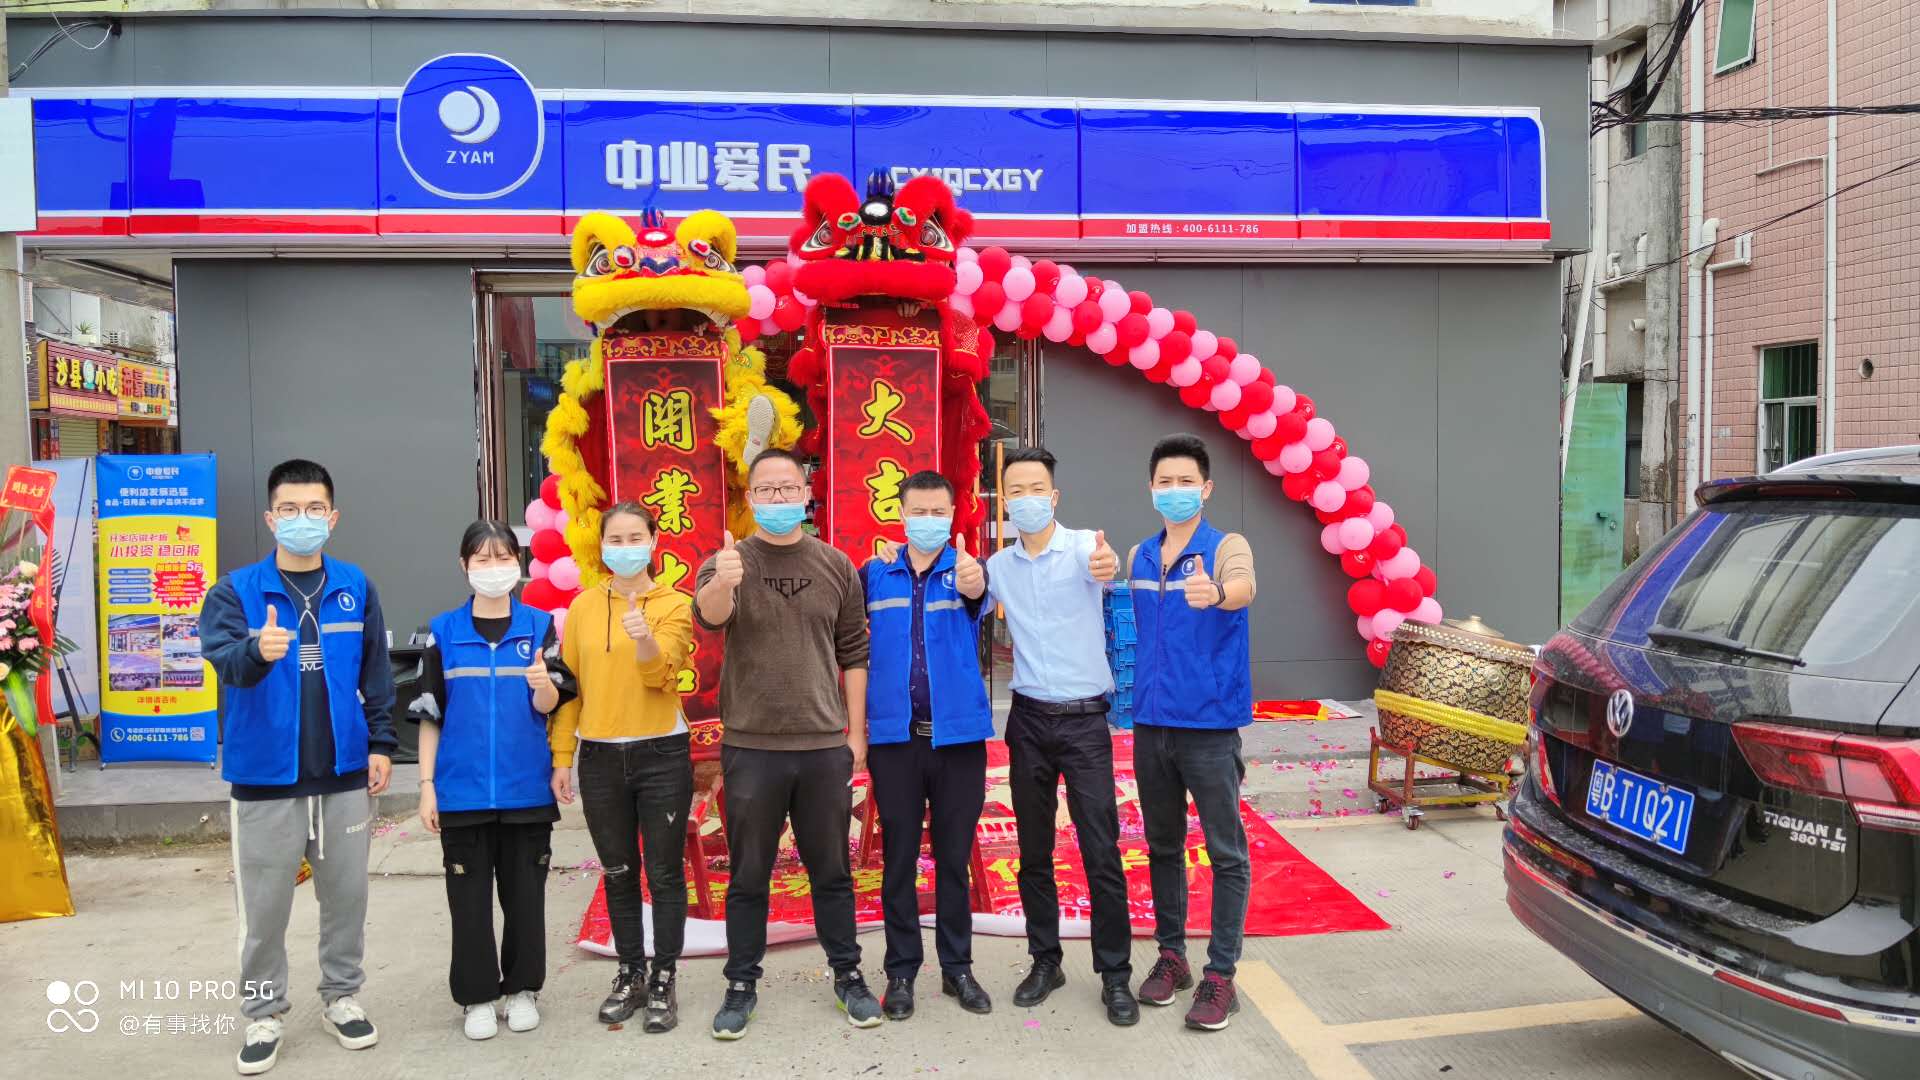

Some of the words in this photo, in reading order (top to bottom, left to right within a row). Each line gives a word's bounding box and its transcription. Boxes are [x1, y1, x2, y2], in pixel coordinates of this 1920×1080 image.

[446, 150, 494, 164] ZYAM
[605, 140, 812, 192] 中业爱民
[860, 381, 914, 556] 大吉
[641, 388, 700, 693] 開業大
[1763, 810, 1829, 838] TIGUAN
[1835, 828, 1847, 842] L
[1789, 831, 1817, 846] 380
